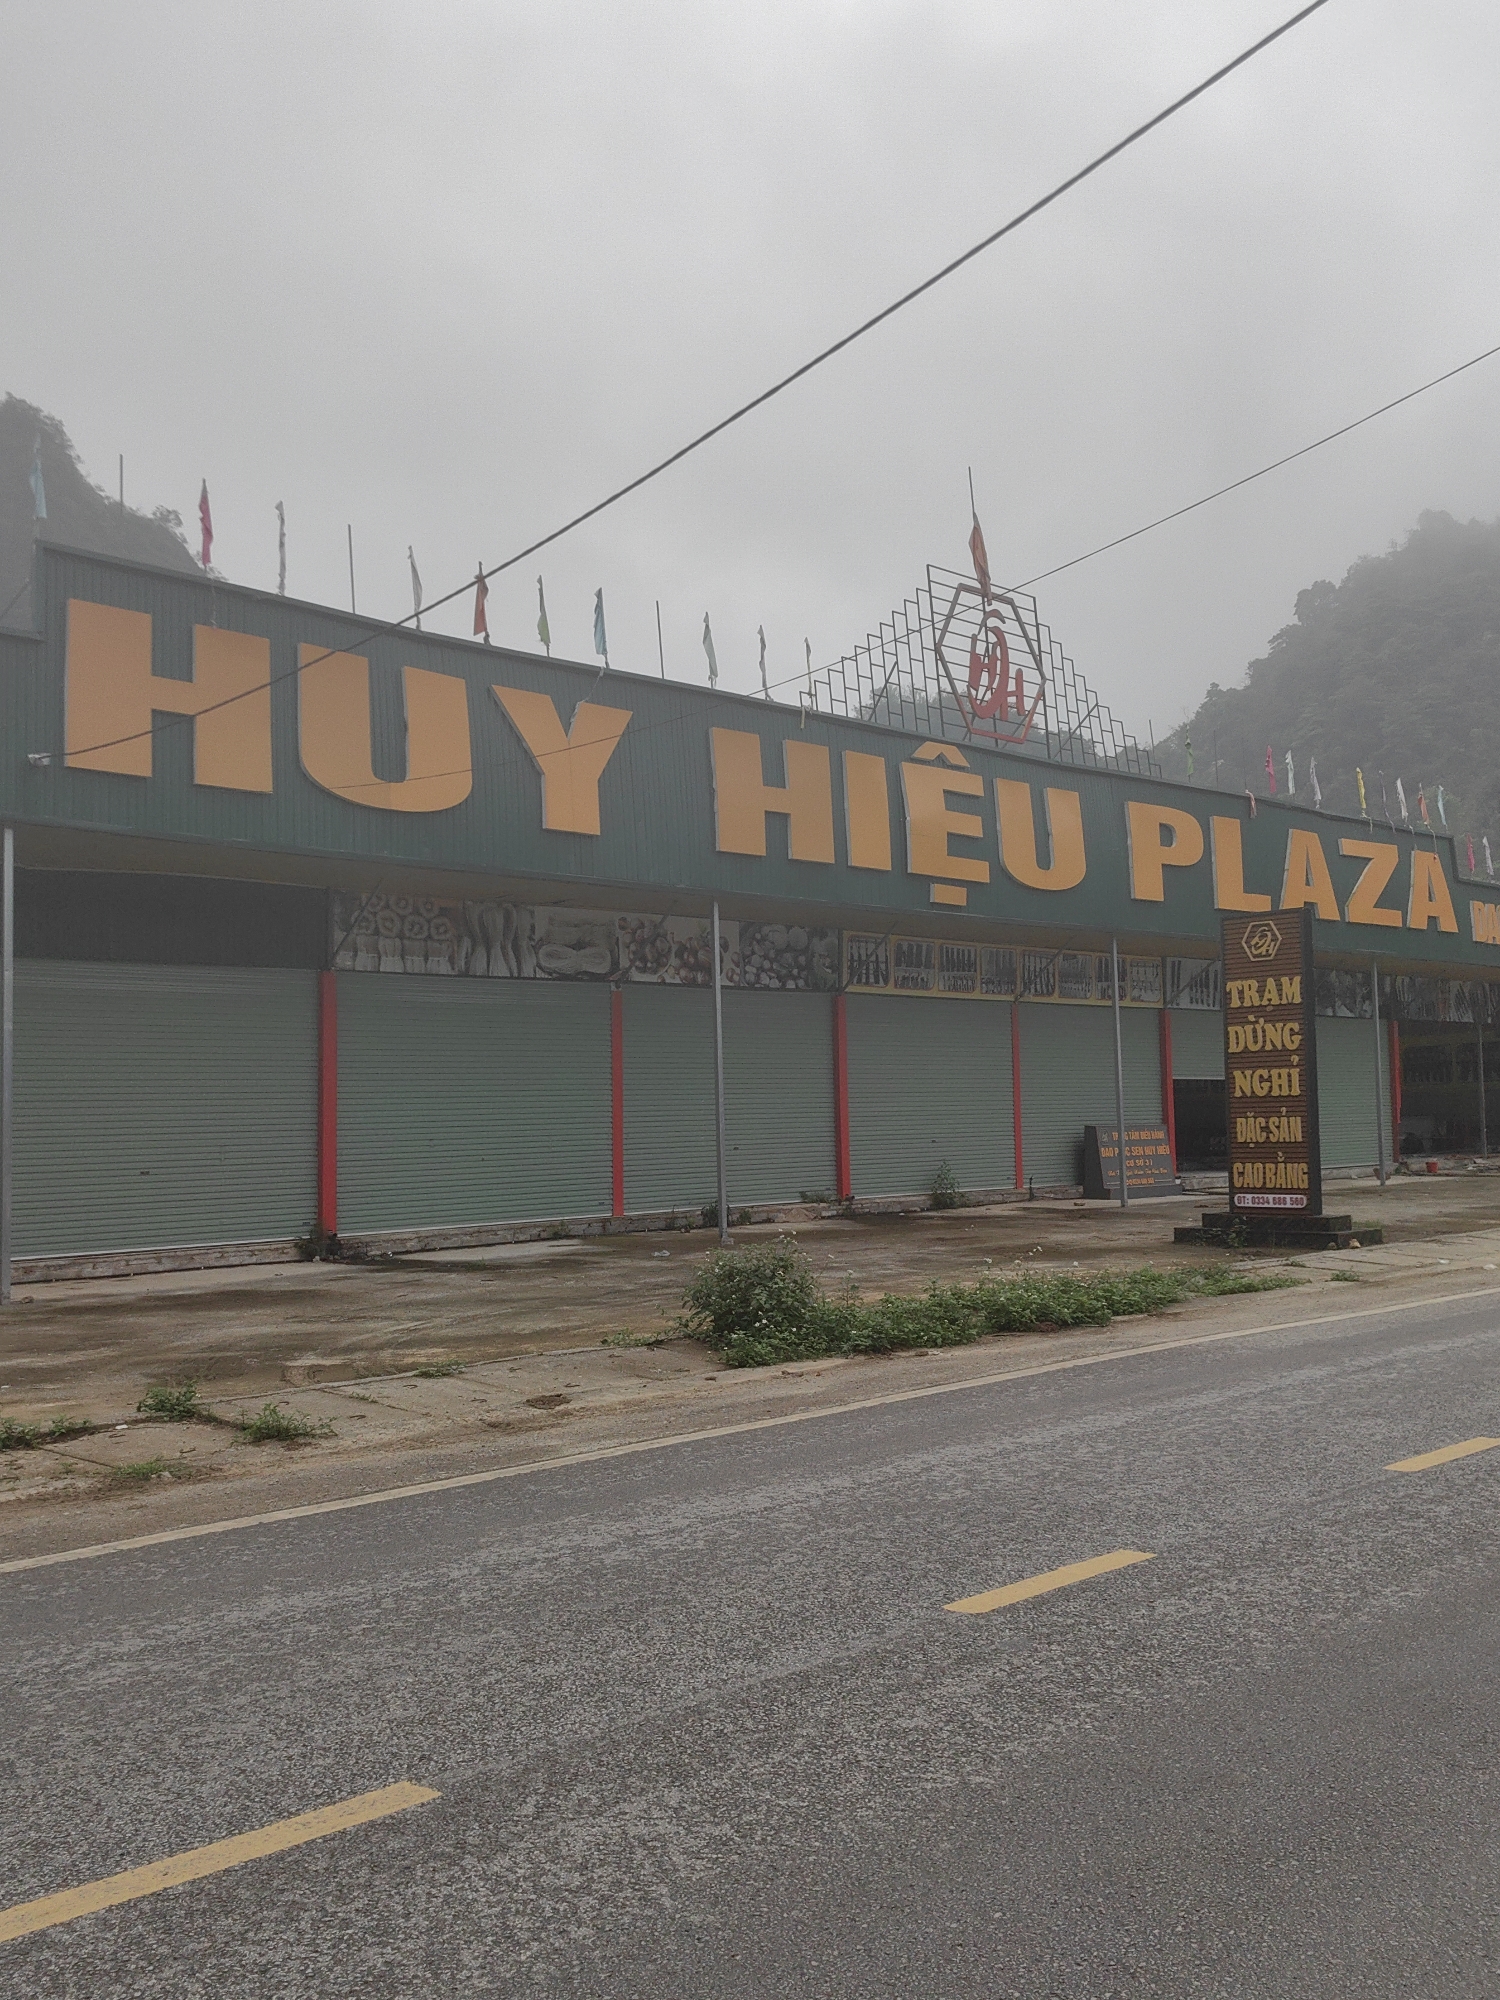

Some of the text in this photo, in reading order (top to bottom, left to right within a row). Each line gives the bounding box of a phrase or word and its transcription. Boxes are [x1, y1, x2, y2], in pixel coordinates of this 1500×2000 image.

[64, 598, 633, 835] HUY
[710, 727, 1087, 906] HIỆU
[1125, 801, 1459, 933] PLAZA
[1226, 976, 1302, 1011] TRẠM
[1227, 1014, 1302, 1053] DỪNG
[1233, 1055, 1301, 1097] NGHỈ
[1269, 1107, 1303, 1143] SẢN
[1233, 1162, 1264, 1188] CAO
